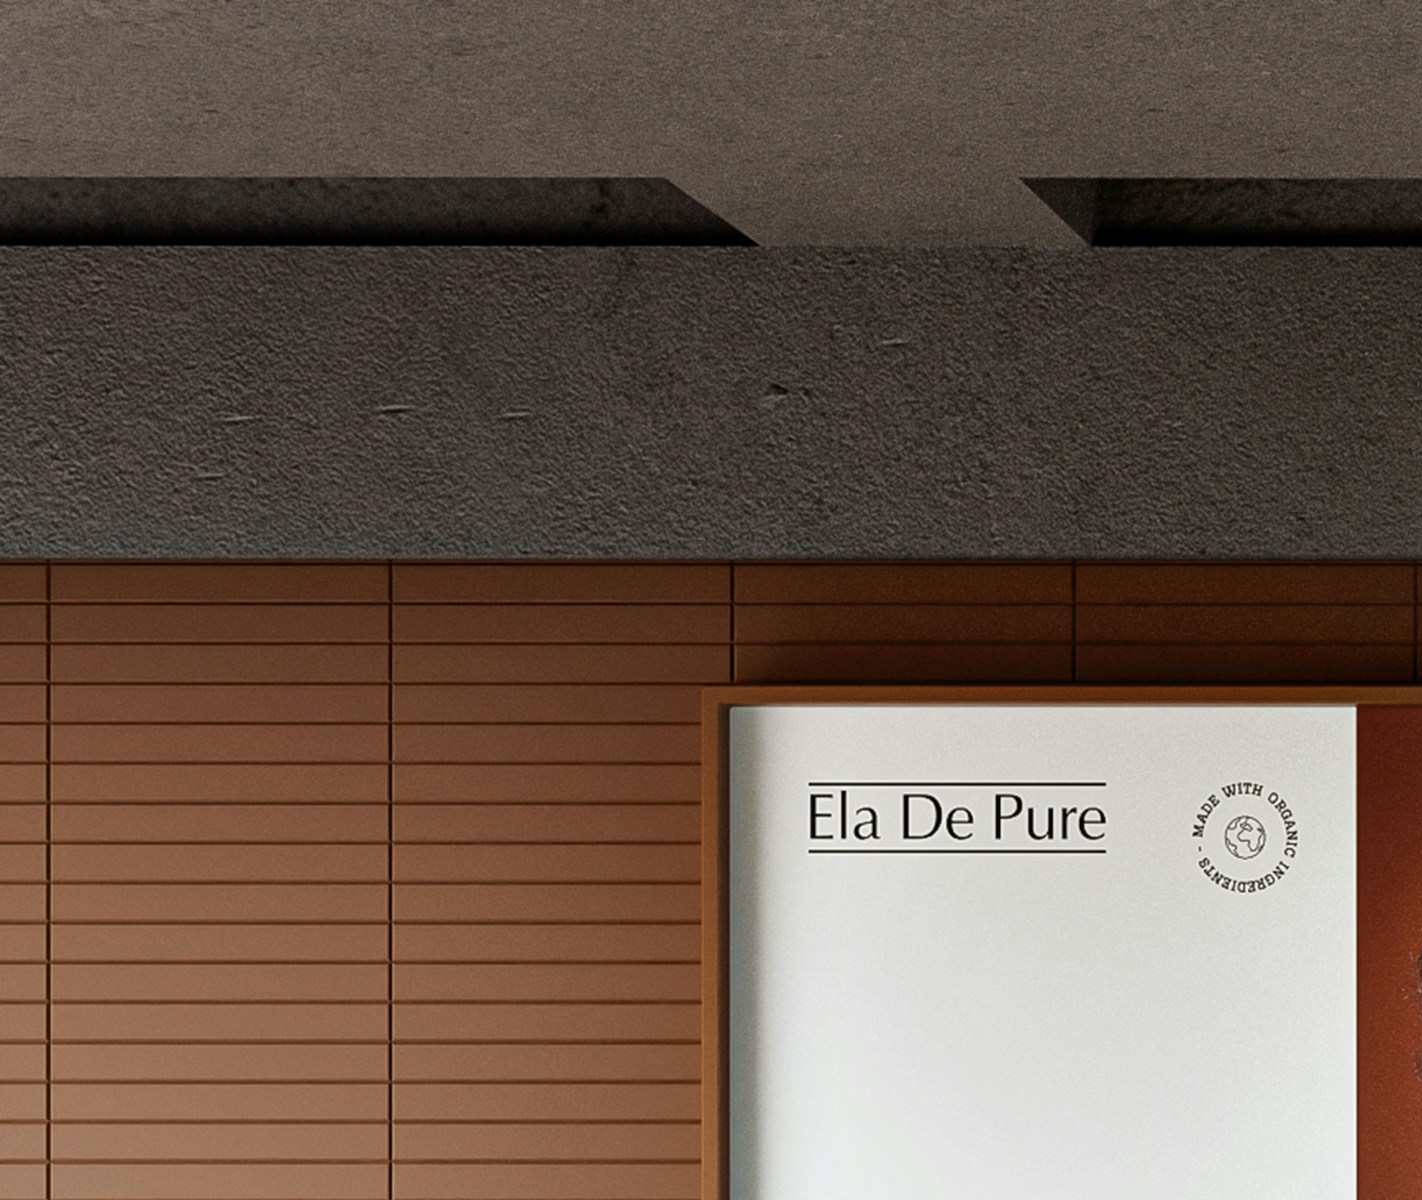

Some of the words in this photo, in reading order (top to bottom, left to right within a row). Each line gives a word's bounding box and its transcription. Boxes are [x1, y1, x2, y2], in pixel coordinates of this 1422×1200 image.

[1221, 782, 1264, 798] WITH
[809, 790, 880, 841] Ela
[902, 793, 974, 841] De
[995, 793, 1107, 841] Pure
[1192, 794, 1220, 838] MADE
[1267, 791, 1298, 858] ORGANIC
[1198, 857, 1290, 893] INGREDIENTS
